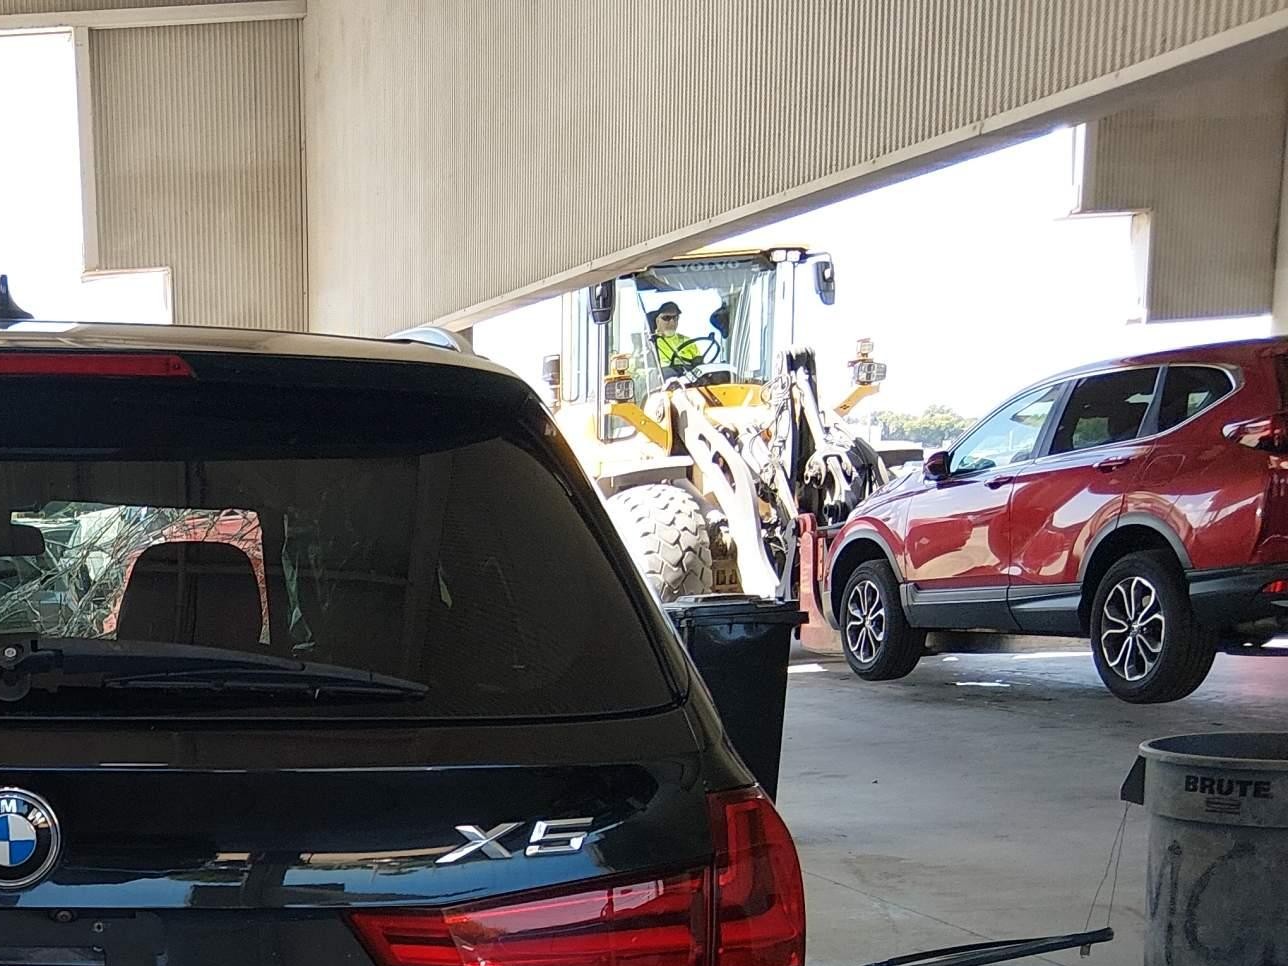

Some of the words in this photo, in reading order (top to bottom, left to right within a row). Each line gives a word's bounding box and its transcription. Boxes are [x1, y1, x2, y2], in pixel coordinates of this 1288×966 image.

[677, 261, 739, 272] VOLVO
[1184, 775, 1274, 799] BRUTE
[434, 817, 595, 864] X5
